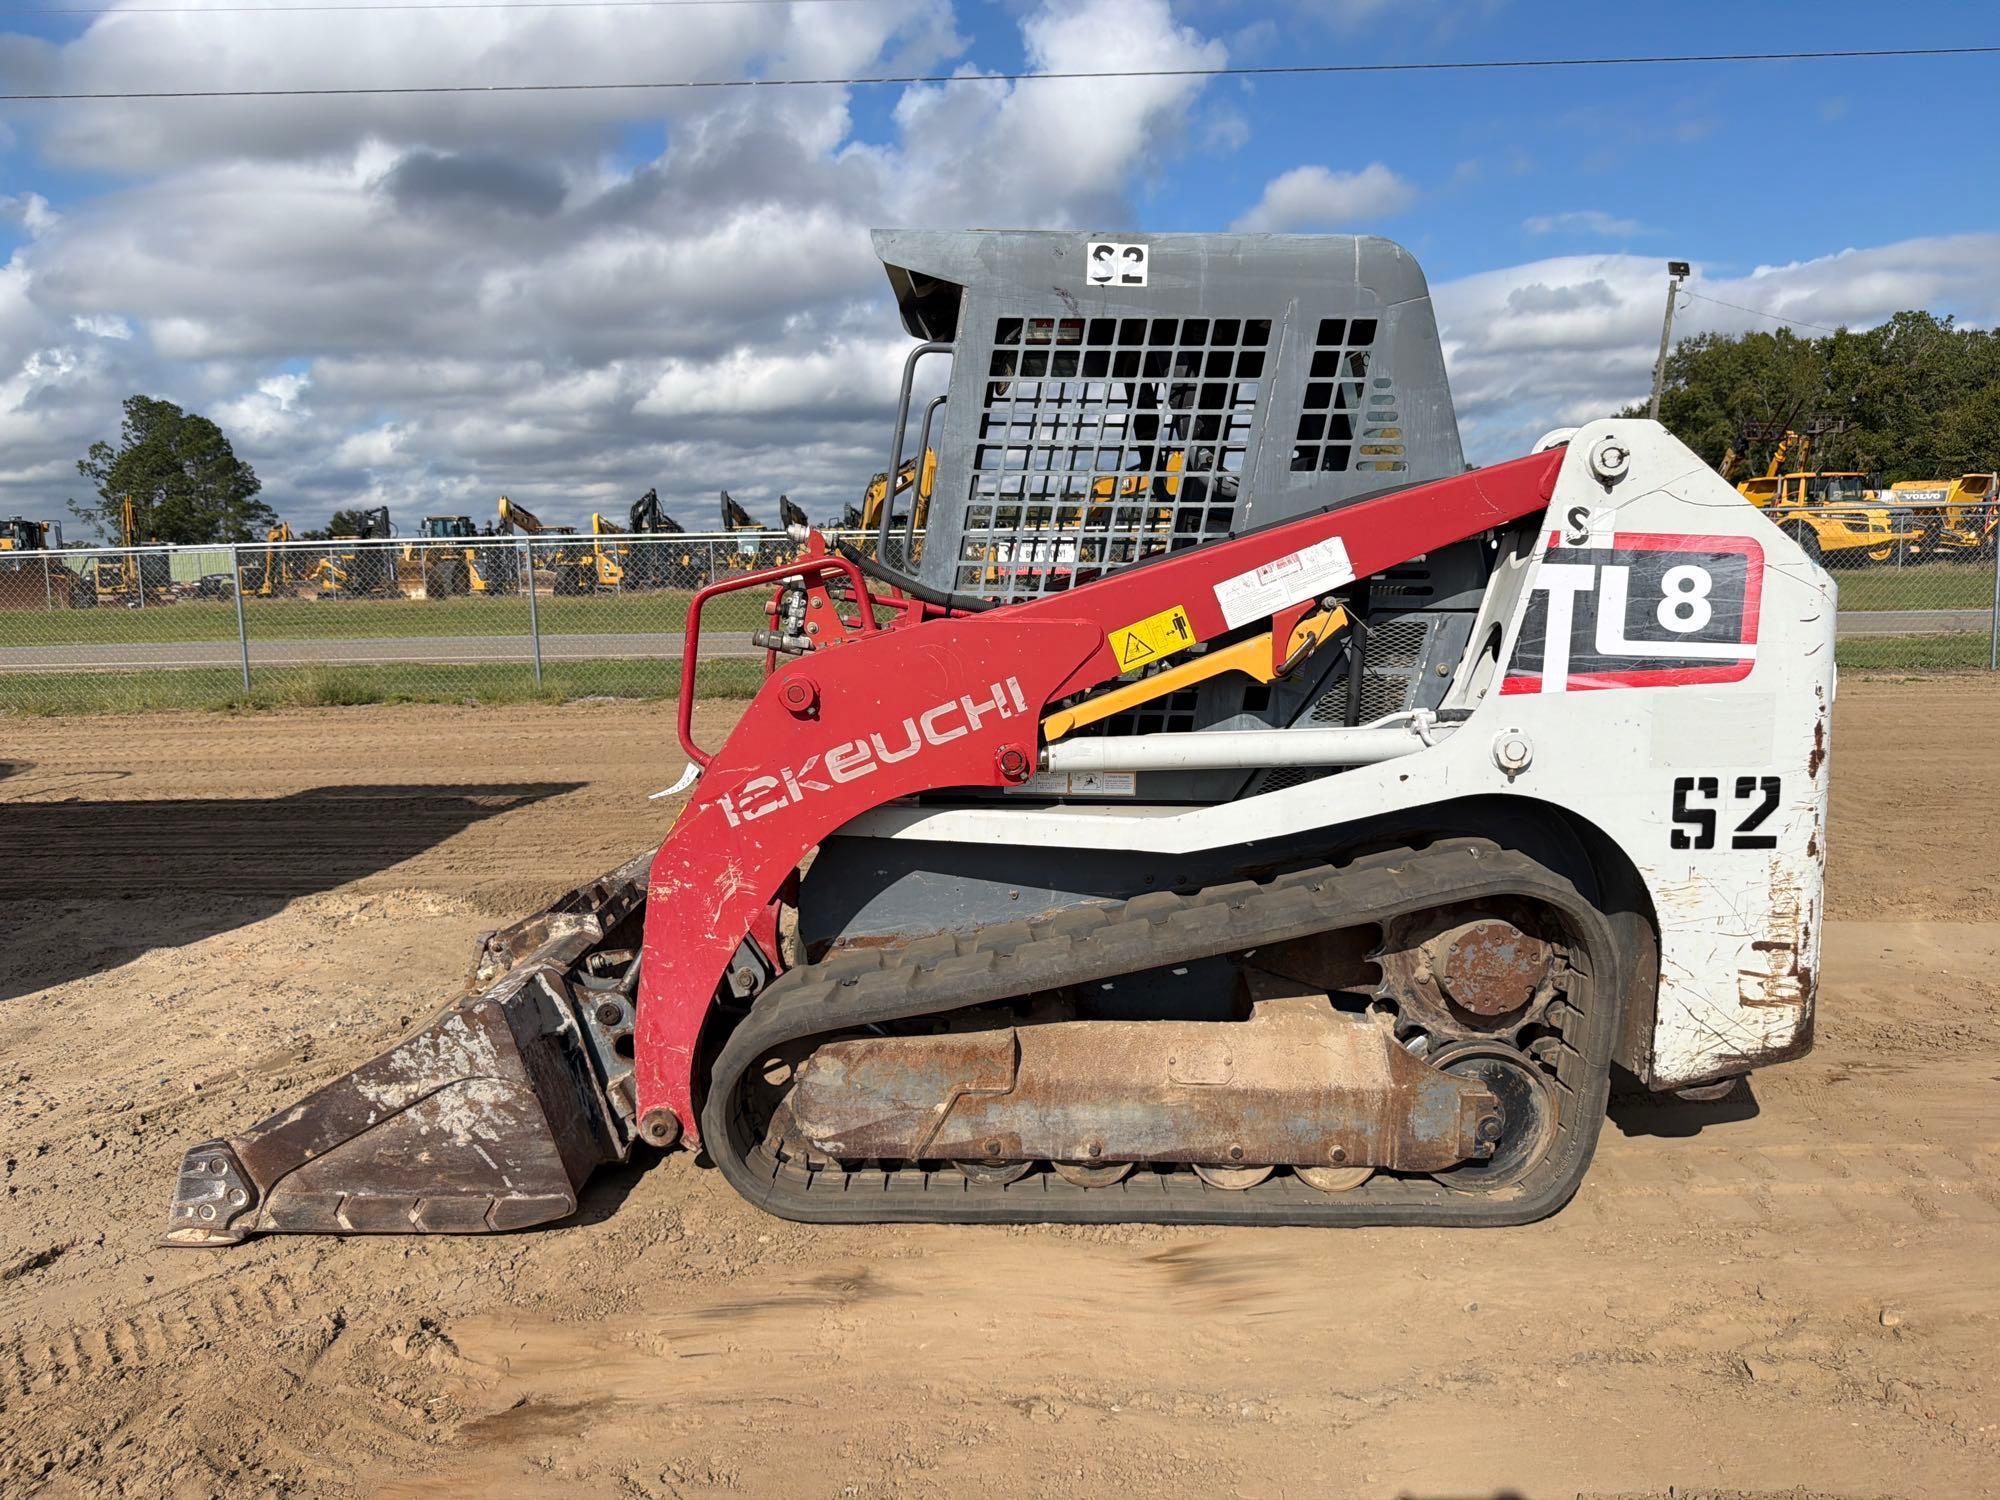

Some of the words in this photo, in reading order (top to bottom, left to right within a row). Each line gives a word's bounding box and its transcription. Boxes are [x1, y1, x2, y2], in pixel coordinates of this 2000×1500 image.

[1092, 244, 1144, 284] S2
[1904, 492, 1941, 500] VOLVO
[1532, 563, 1757, 693] TL8
[1670, 776, 1781, 850] S2
